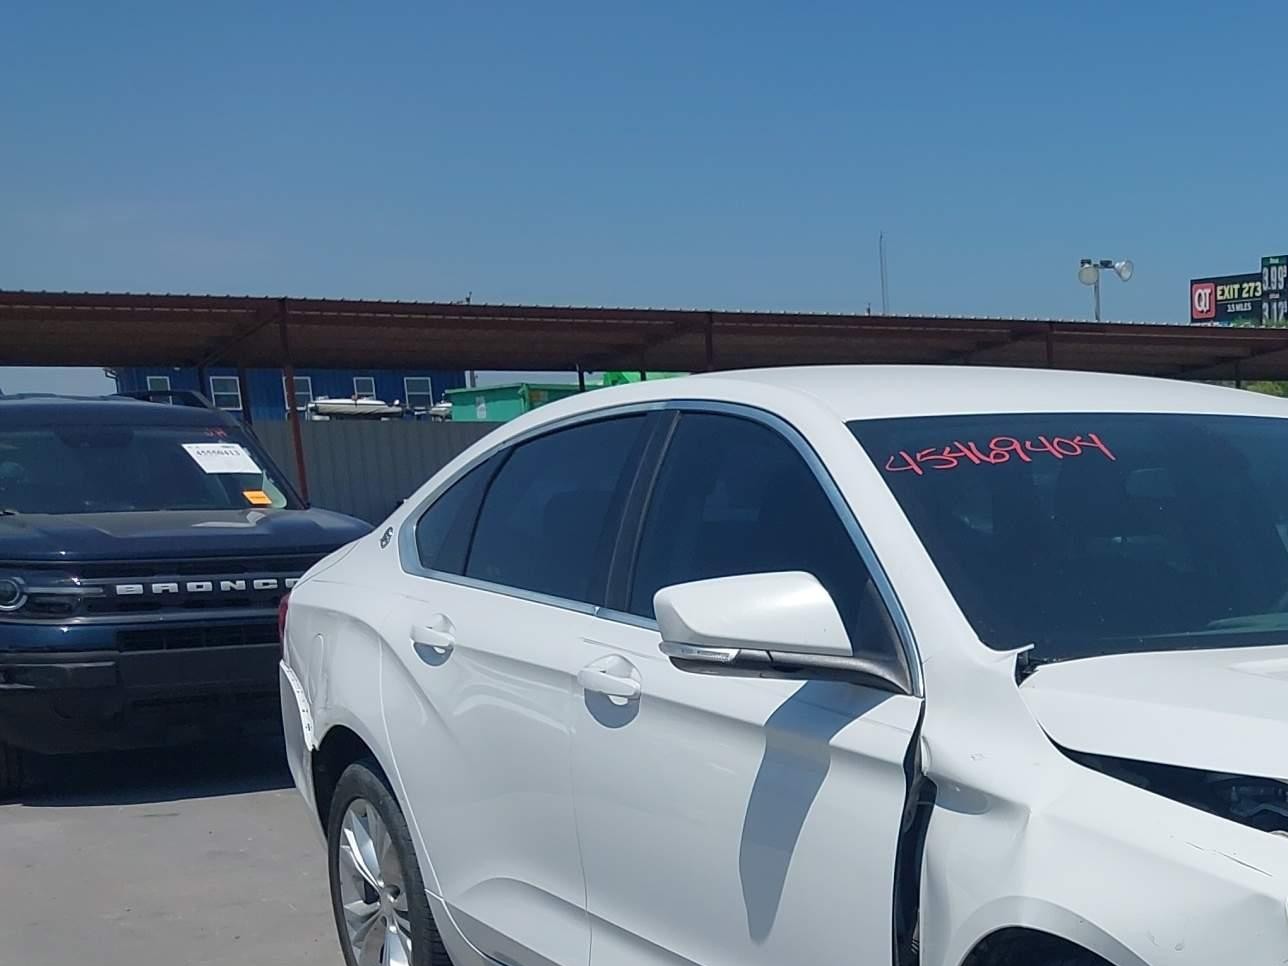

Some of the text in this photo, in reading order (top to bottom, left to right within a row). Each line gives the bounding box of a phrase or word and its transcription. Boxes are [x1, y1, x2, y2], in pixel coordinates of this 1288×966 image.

[1195, 288, 1211, 312] QT
[1217, 281, 1262, 300] EXIT 273
[1235, 302, 1252, 312] MILES
[885, 433, 1116, 475] 45469404
